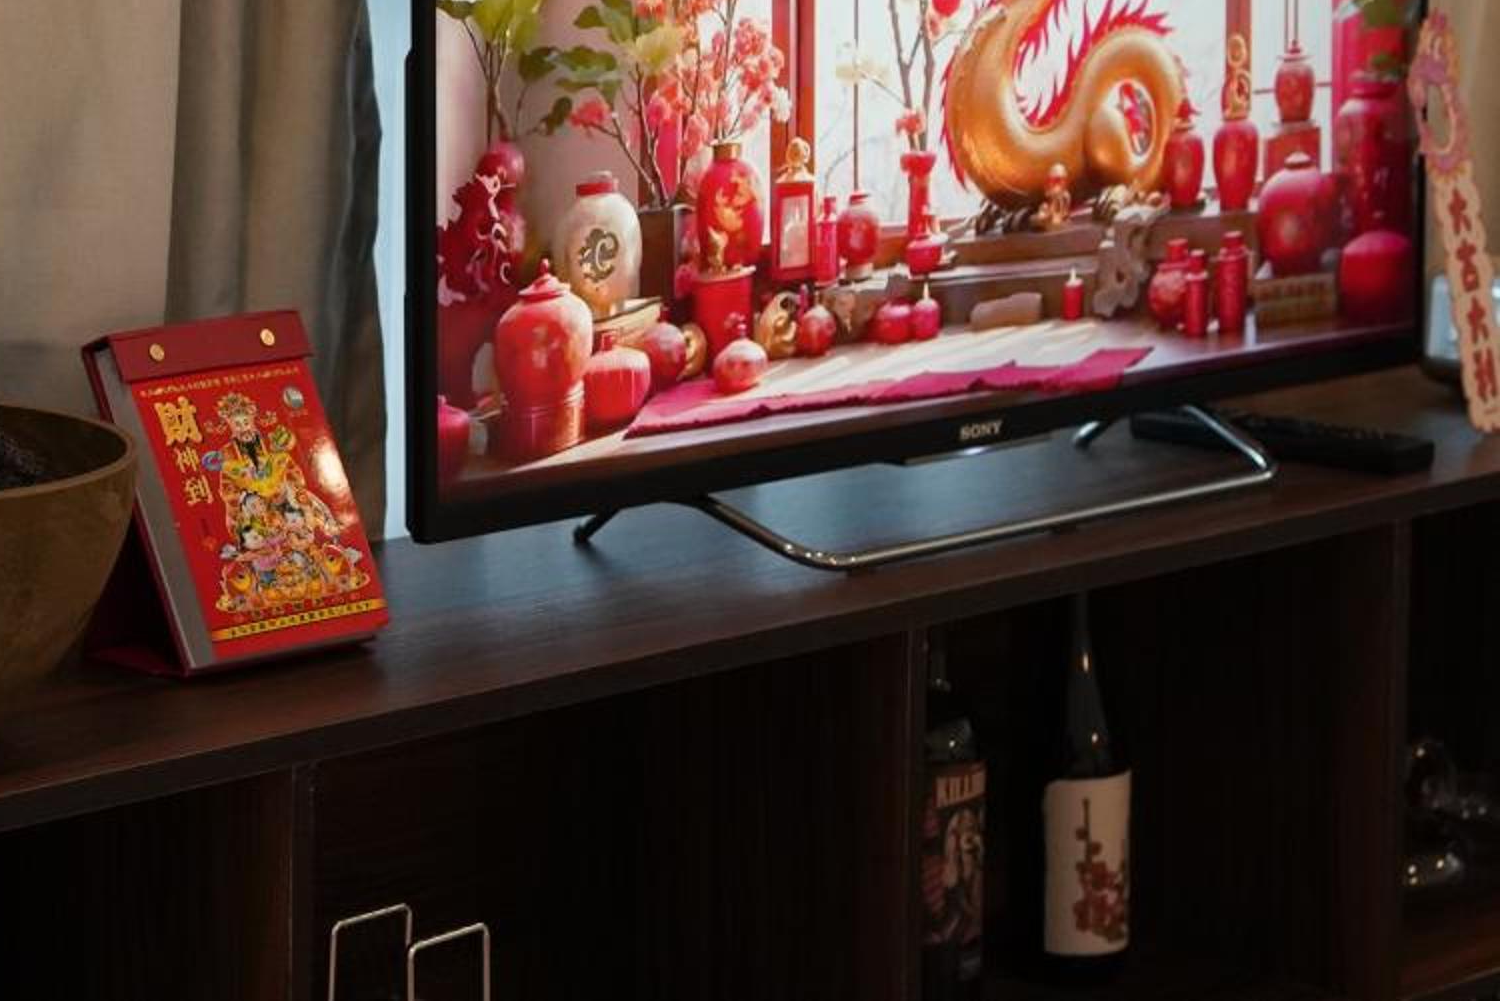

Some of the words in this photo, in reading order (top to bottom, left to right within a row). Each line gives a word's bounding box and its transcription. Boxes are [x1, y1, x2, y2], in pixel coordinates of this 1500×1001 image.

[1447, 187, 1499, 401] 大吉大利
[959, 419, 1003, 441] SONY
